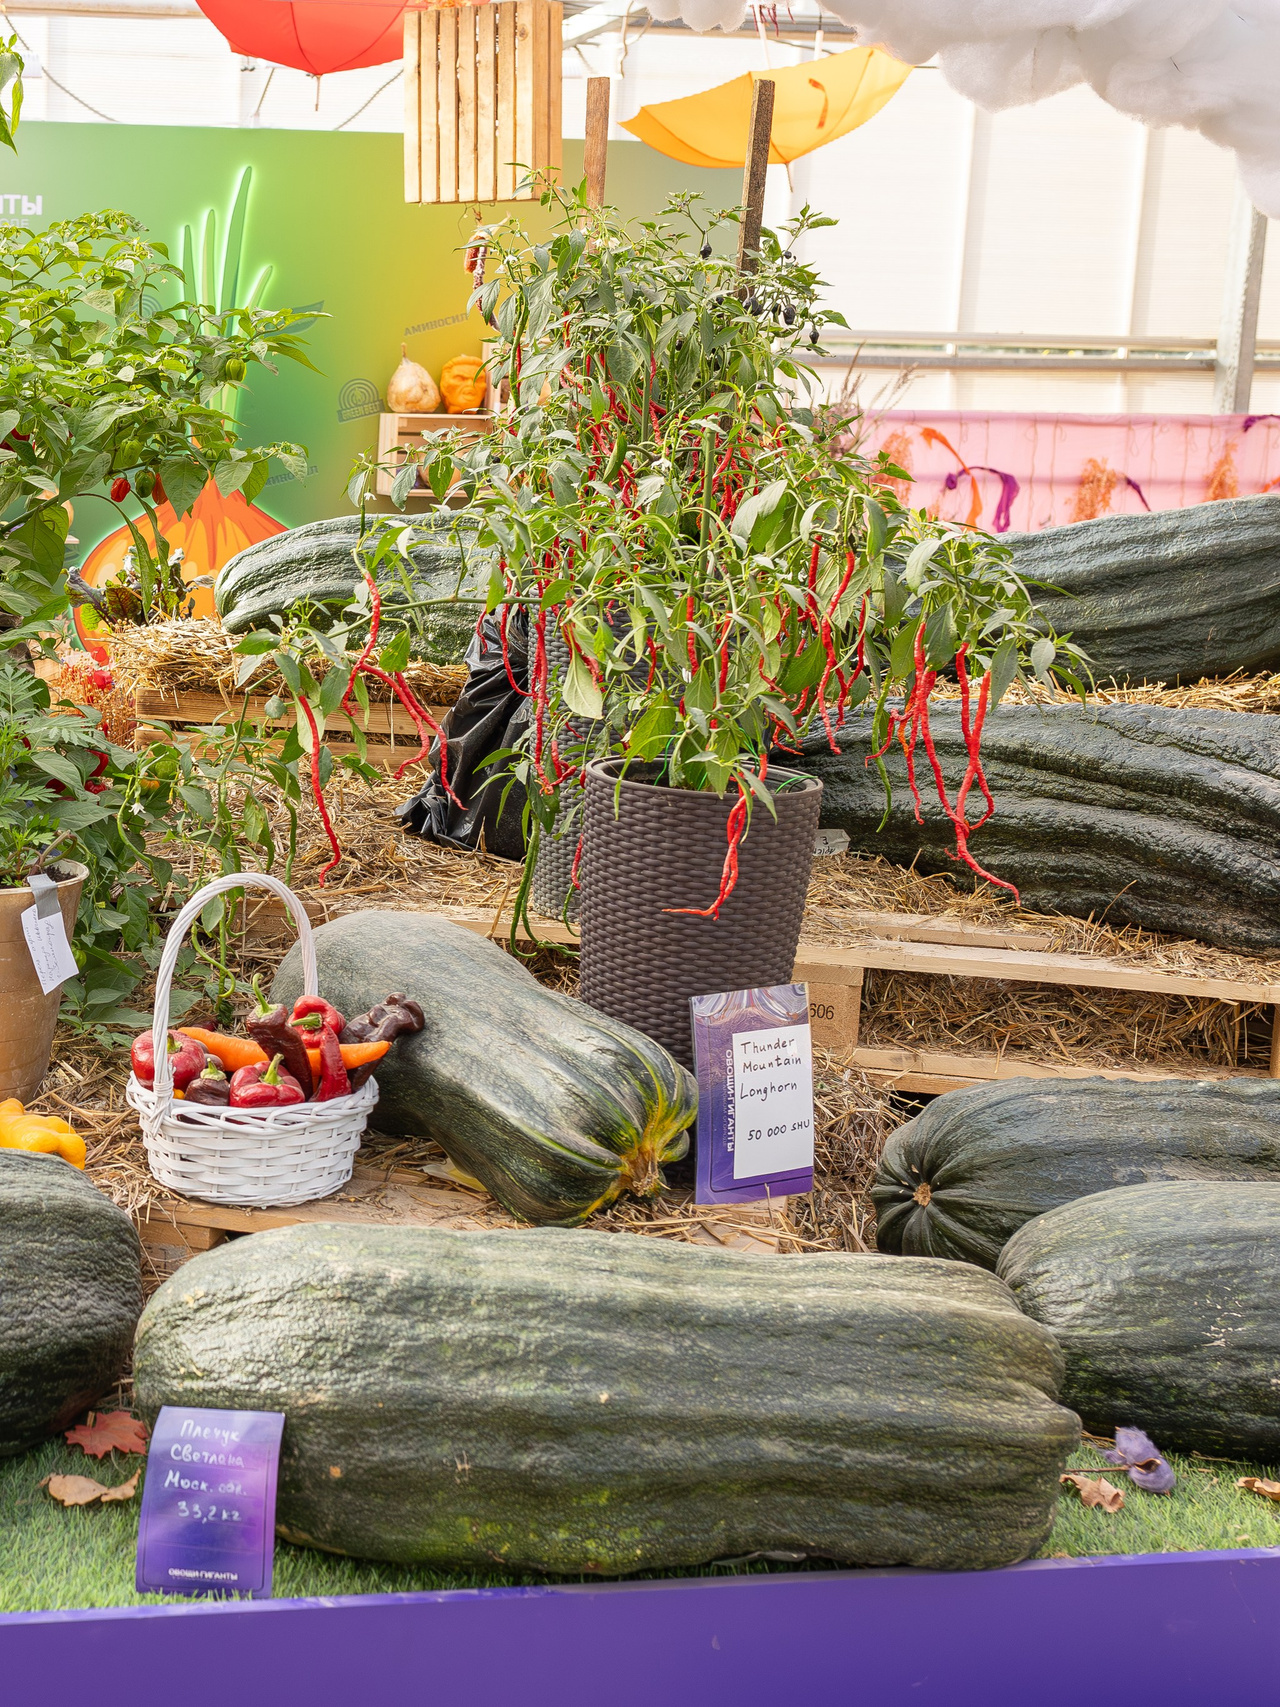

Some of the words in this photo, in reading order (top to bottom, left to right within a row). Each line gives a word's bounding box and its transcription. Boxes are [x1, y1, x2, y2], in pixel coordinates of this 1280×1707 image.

[741, 1038, 795, 1054] Thunder
[742, 1056, 801, 1073] Mountain
[726, 1050, 735, 1152] ОВОЩИ-ГИГАНТЫ
[740, 1082, 797, 1101] Longhorn
[747, 1129, 762, 1141] 50
[767, 1125, 787, 1138] 000
[791, 1119, 810, 1132] SHU
[180, 1419, 241, 1447] Плечук
[170, 1443, 245, 1468] Светлана
